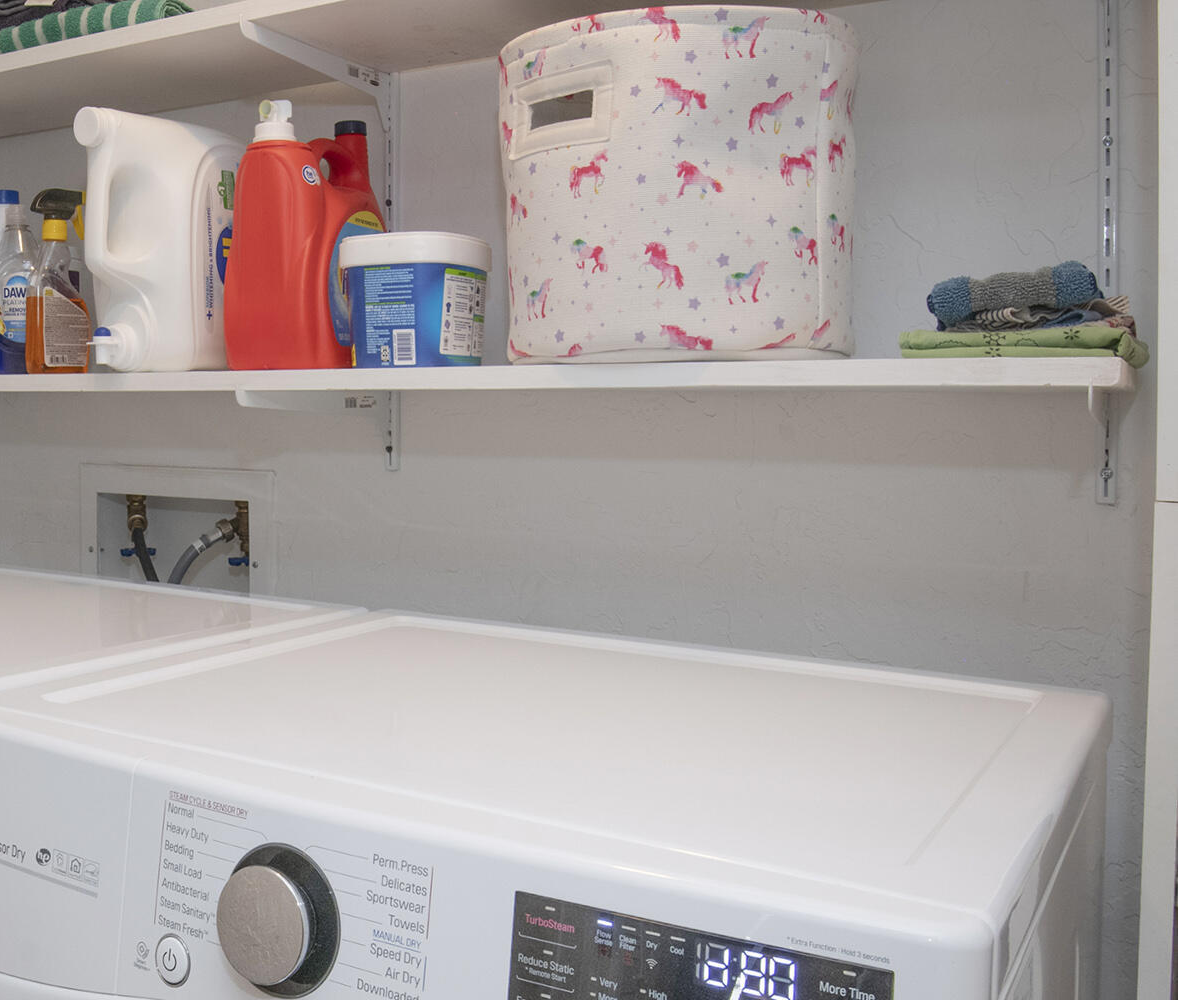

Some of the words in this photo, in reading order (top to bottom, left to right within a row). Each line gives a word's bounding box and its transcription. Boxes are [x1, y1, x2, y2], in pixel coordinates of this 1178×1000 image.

[4, 287, 27, 298] DAW
[167, 802, 194, 818] Normal
[169, 790, 189, 801] STEAM
[188, 797, 206, 805] CYCLE
[212, 801, 236, 815] SENSOR
[236, 807, 248, 817] DRY
[165, 821, 190, 839] Heavy
[190, 827, 209, 844] Duty
[11, 844, 26, 863] Dry
[164, 839, 194, 860] Bedding
[162, 858, 182, 874] Small
[183, 864, 202, 880] Load
[161, 878, 210, 902] Antibacterial
[381, 874, 428, 897] Delicates
[159, 895, 181, 913] Steam
[366, 889, 426, 914] Sportswear
[158, 914, 181, 931] Steam
[387, 913, 425, 934] Towels
[525, 913, 575, 933] TurboSteam
[372, 928, 405, 945] MANUAL
[406, 937, 422, 949] DRY
[594, 935, 613, 947] Sense
[596, 928, 612, 939] Flow
[618, 934, 637, 945] Clean
[369, 942, 402, 962] Speed
[403, 951, 422, 968] Dry
[645, 940, 658, 951] Dry
[669, 946, 685, 956] Cool
[790, 937, 808, 947] Extra
[808, 940, 837, 953] Function
[841, 948, 856, 957] Hold
[862, 953, 891, 965] seconds
[517, 953, 549, 969] Reduce
[549, 960, 575, 976] Static
[384, 966, 401, 980] Air
[402, 970, 421, 988] Dry
[528, 967, 551, 980] Remote
[550, 972, 567, 983] Start
[599, 976, 618, 990] Very
[648, 989, 668, 1000] High
[818, 980, 847, 997] More
